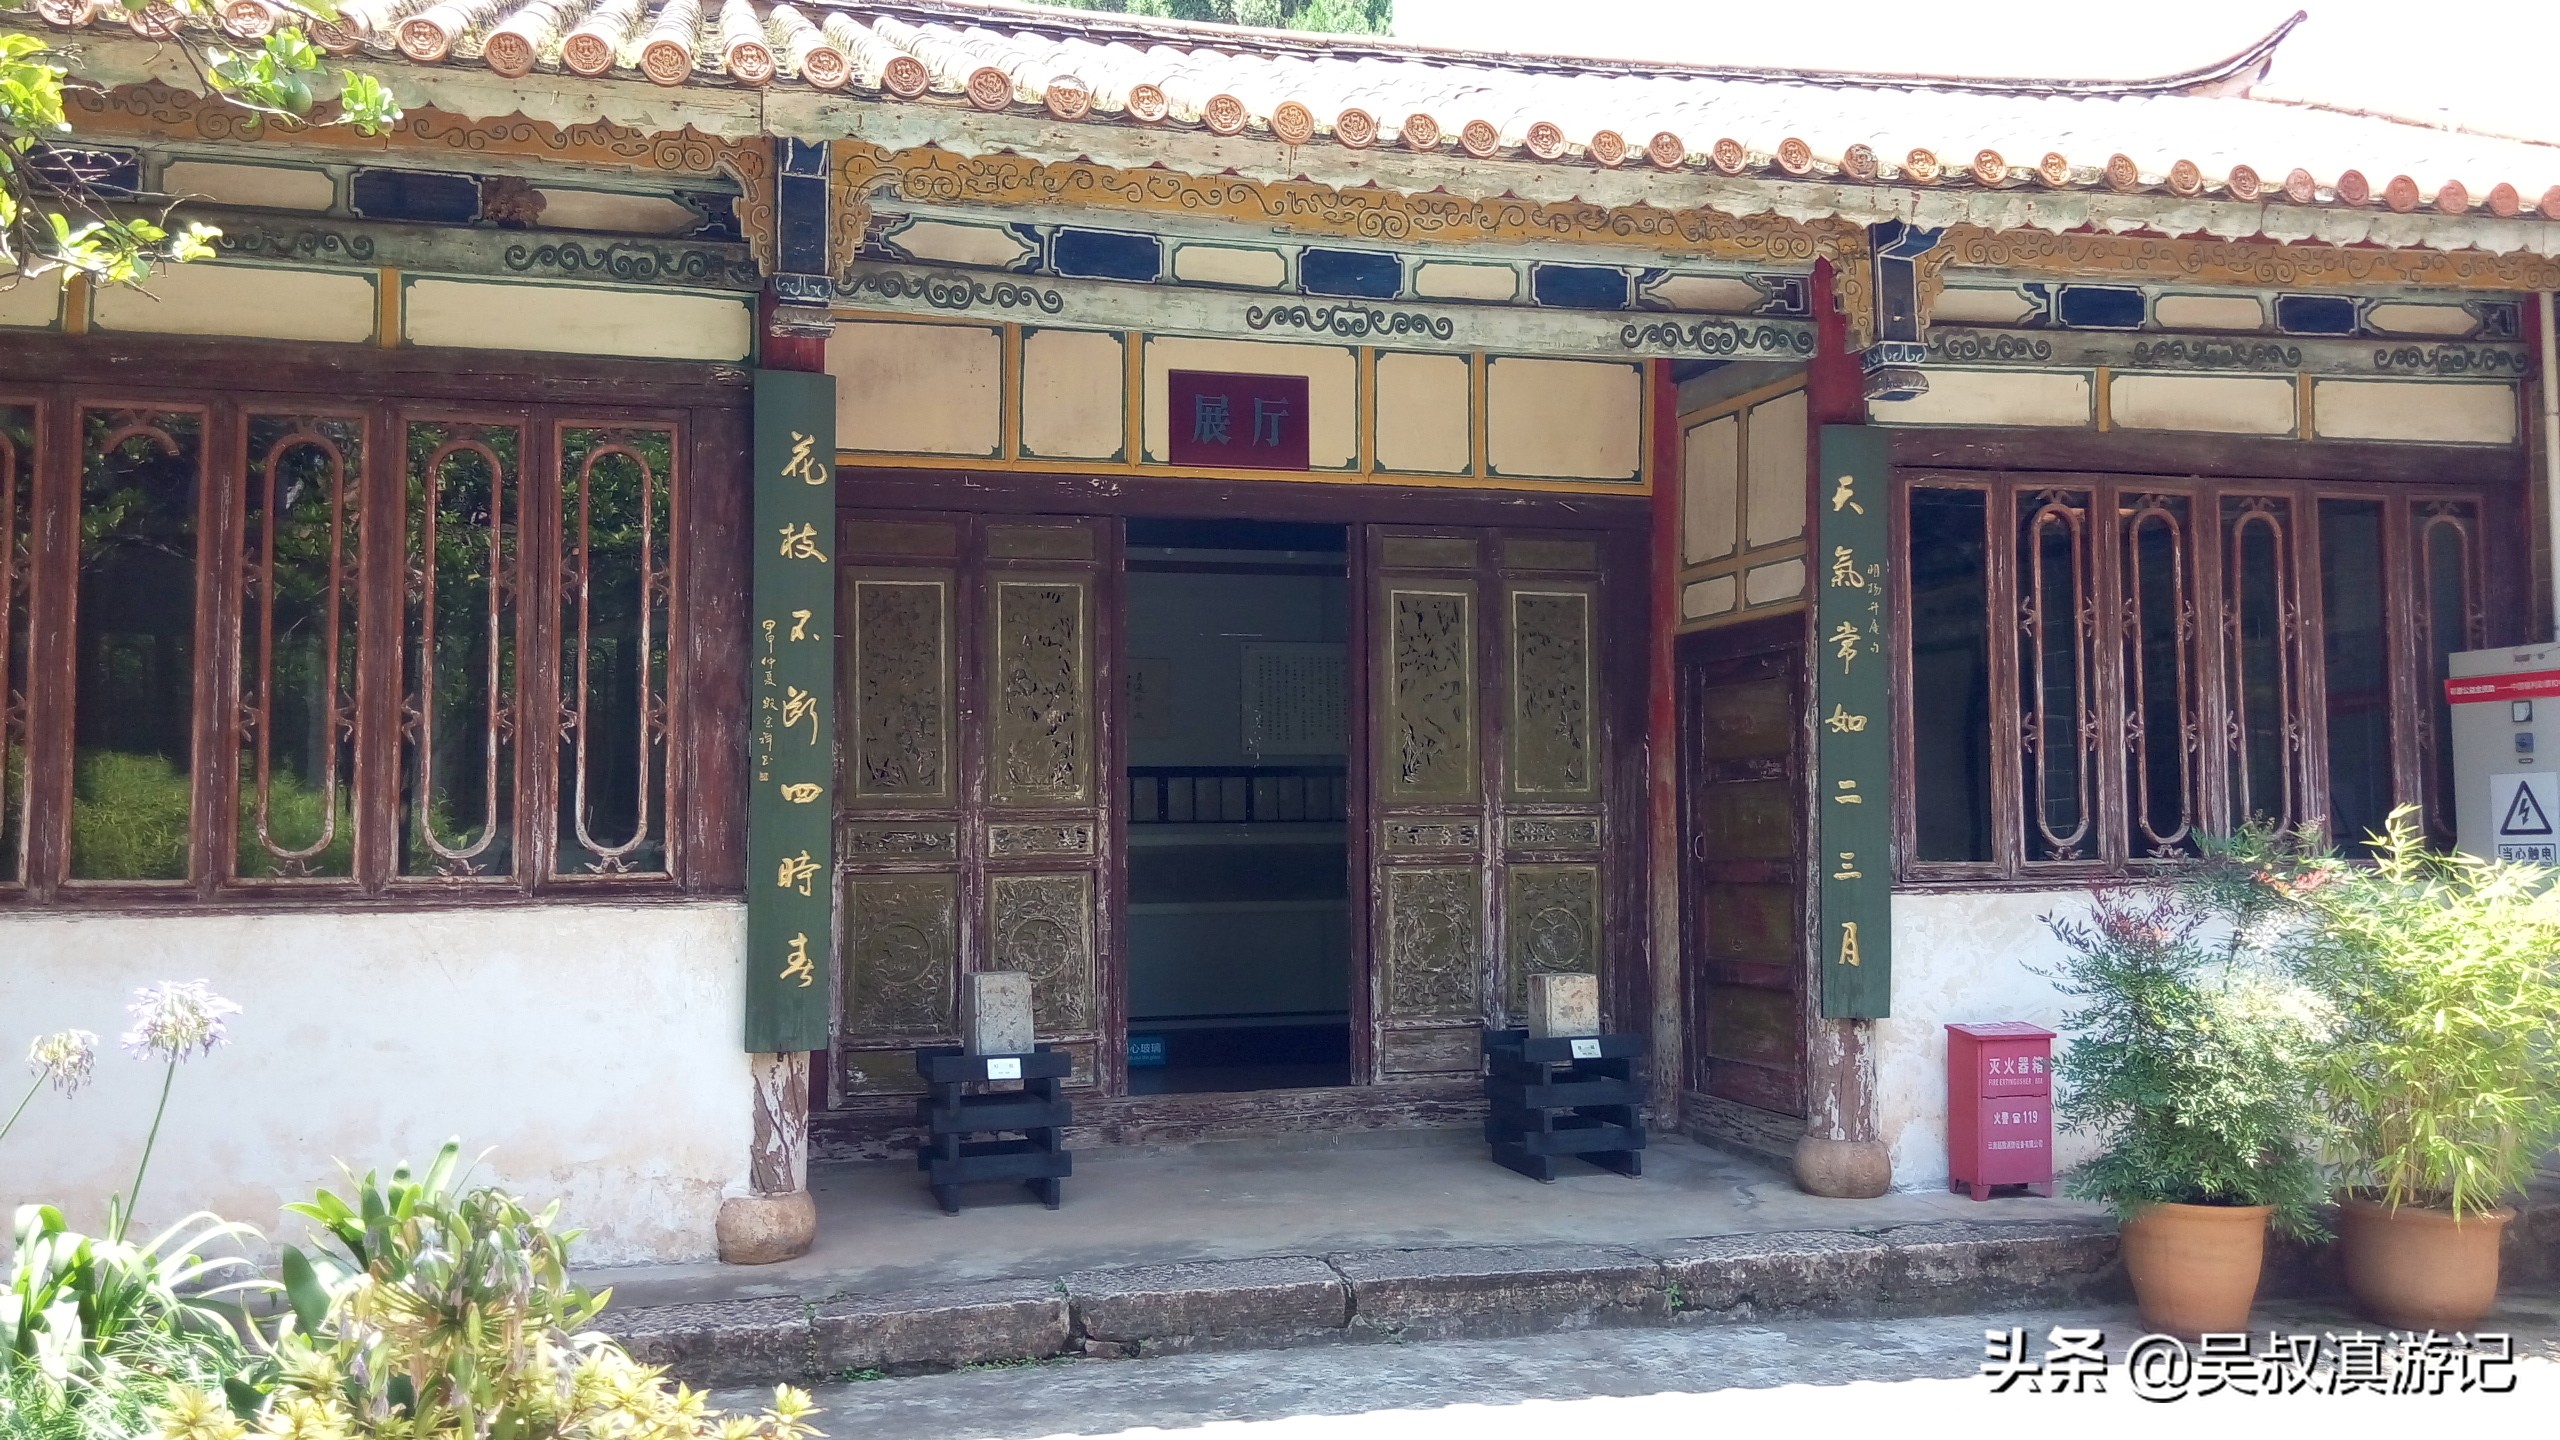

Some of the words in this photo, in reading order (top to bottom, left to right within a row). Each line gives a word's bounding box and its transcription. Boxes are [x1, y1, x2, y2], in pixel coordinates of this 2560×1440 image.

[1192, 393, 1290, 448] 展厅
[2503, 846, 2553, 861] 当心触电
[1129, 1042, 1162, 1054] 心玻璃
[1988, 1056, 2044, 1075] 灭火器箱
[2023, 1110, 2038, 1124] 119
